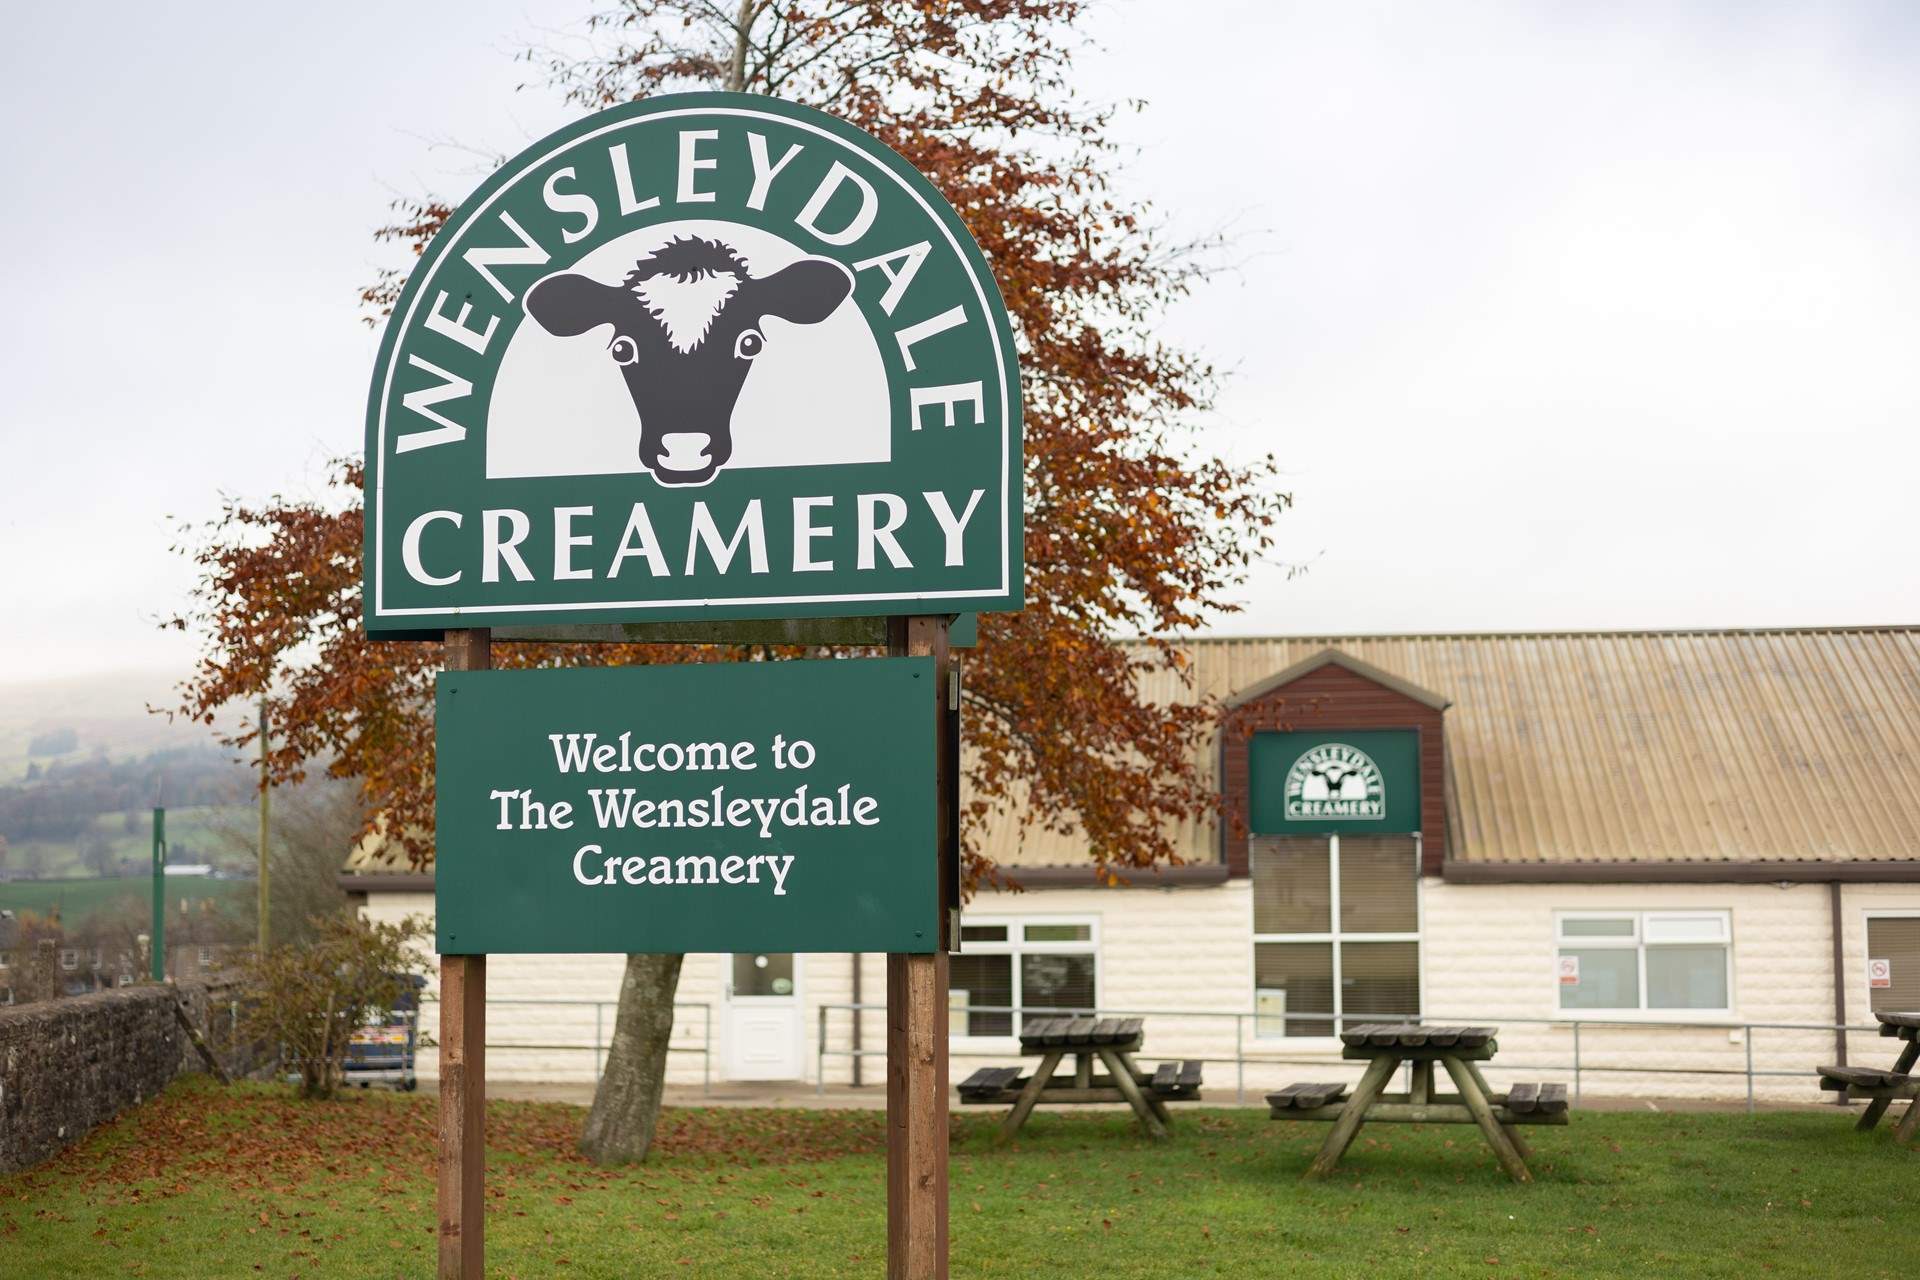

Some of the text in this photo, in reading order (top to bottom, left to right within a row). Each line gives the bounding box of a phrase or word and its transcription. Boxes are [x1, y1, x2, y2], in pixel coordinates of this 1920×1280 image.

[395, 129, 986, 455] WENSLEYDALE
[401, 488, 986, 586] CREAMERY
[549, 731, 816, 774] Welcome to
[490, 783, 881, 840] The Wensleydale
[1290, 800, 1381, 816] CREAMERY
[572, 844, 796, 897] Creamery
